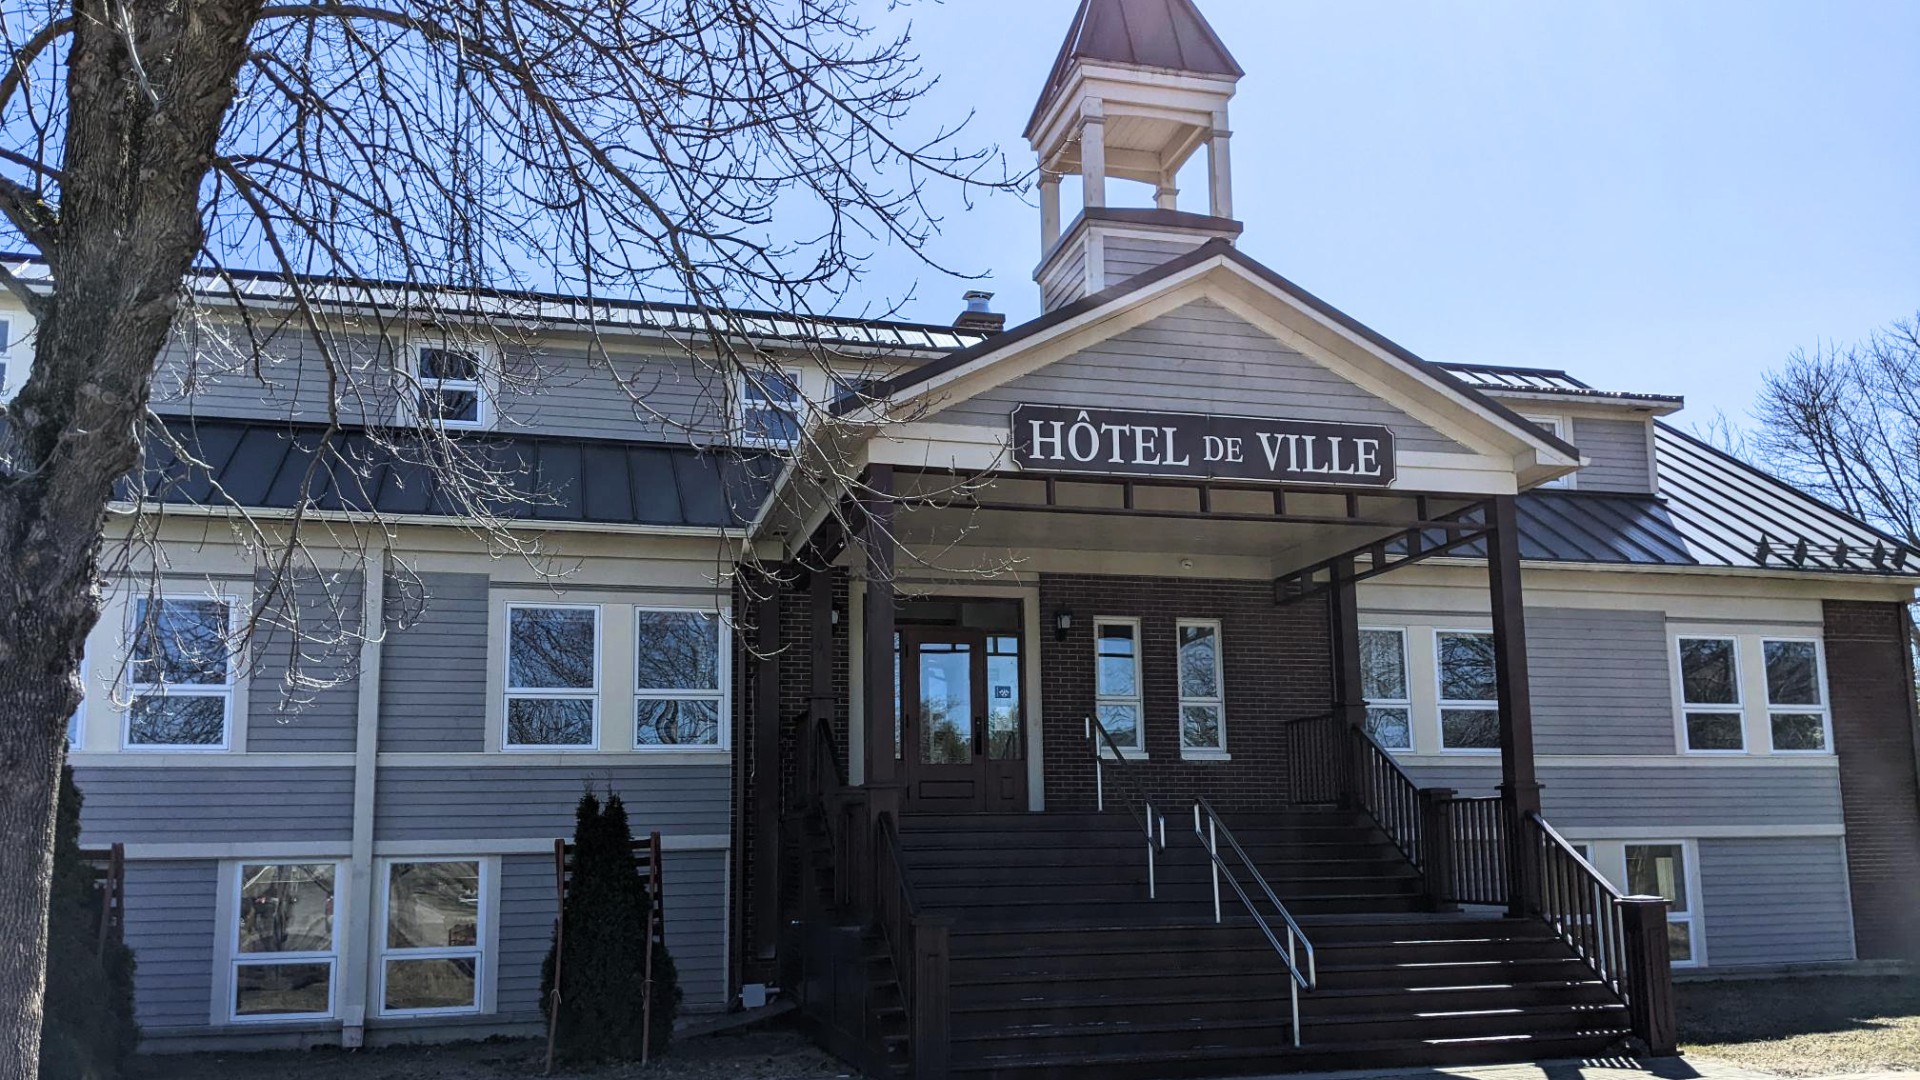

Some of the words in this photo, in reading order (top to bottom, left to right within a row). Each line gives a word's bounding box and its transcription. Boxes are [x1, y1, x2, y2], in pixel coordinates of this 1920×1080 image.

[1029, 411, 1190, 466] HÔTEL
[1203, 435, 1244, 463] DE
[1256, 432, 1382, 476] VILLE
